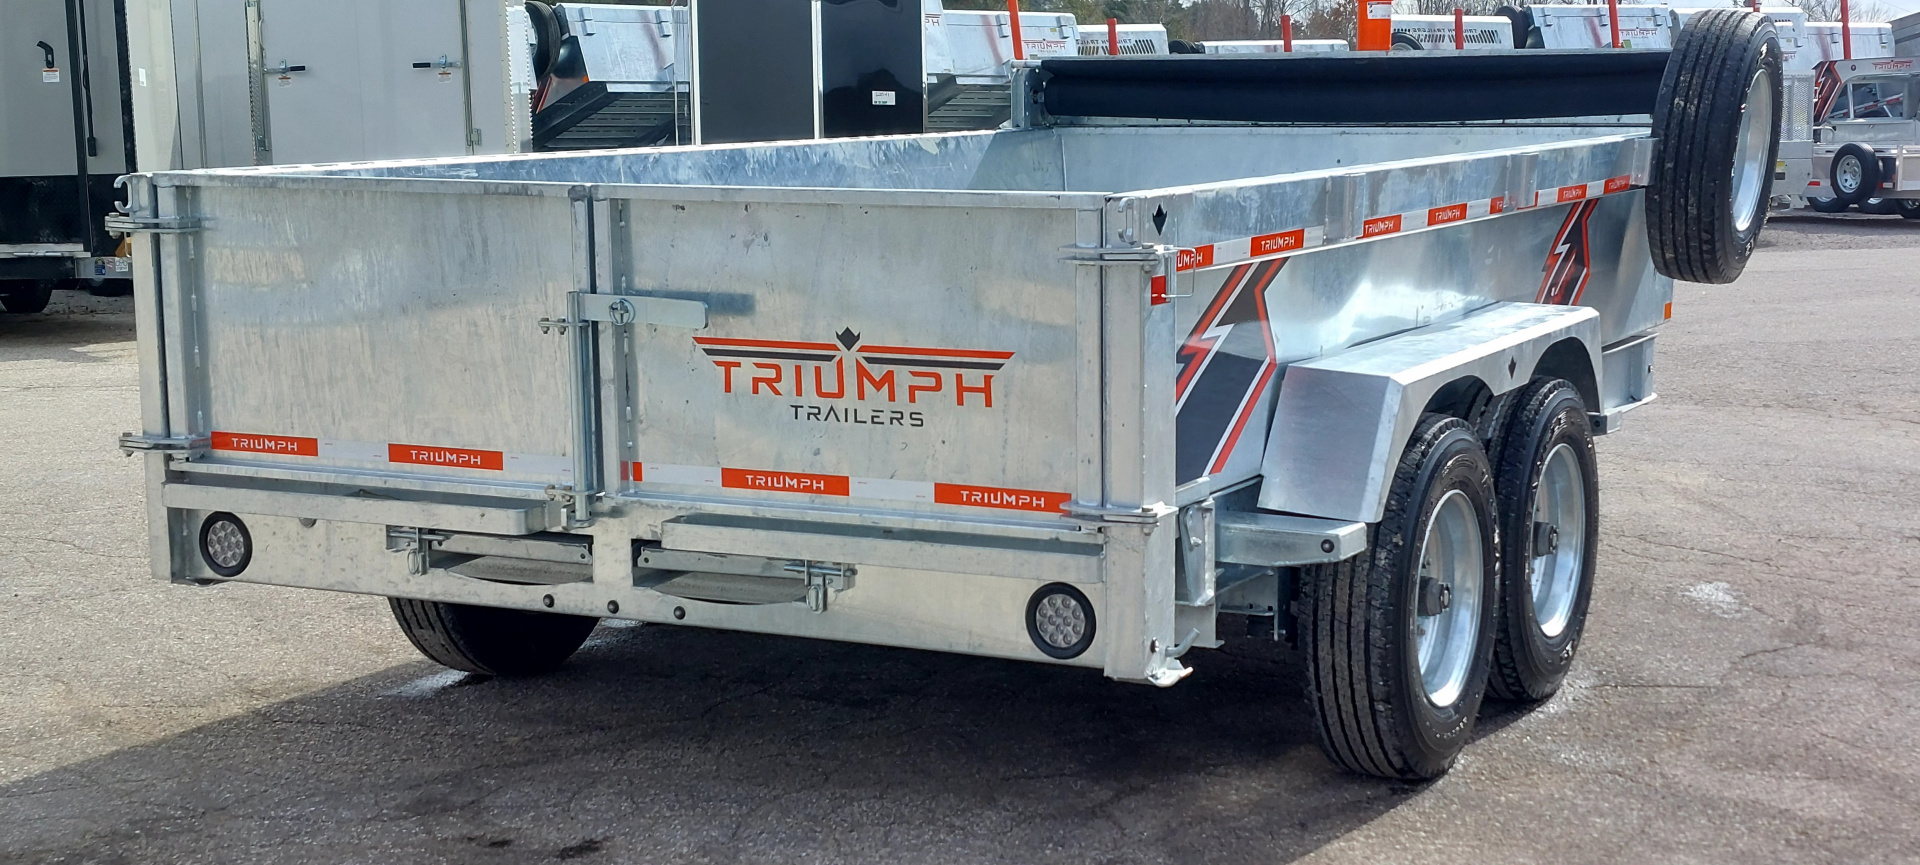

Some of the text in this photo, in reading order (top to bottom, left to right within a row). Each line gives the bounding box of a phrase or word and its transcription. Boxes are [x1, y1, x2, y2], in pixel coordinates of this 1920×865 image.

[1026, 42, 1066, 50] TRIUMPH
[1874, 62, 1912, 70] TRIUMPH
[1435, 209, 1460, 221] TRIUMPH
[1365, 220, 1394, 234] TRIUMPH
[1260, 236, 1295, 251] TRIUMPH
[712, 356, 995, 408] TRIUMPH
[789, 404, 924, 427] TRAILERS
[231, 438, 298, 452] TRIUMPH
[410, 450, 481, 465] TRIUMPH
[745, 475, 825, 491] TRIUMPH
[960, 490, 1045, 508] TRIUMPH
